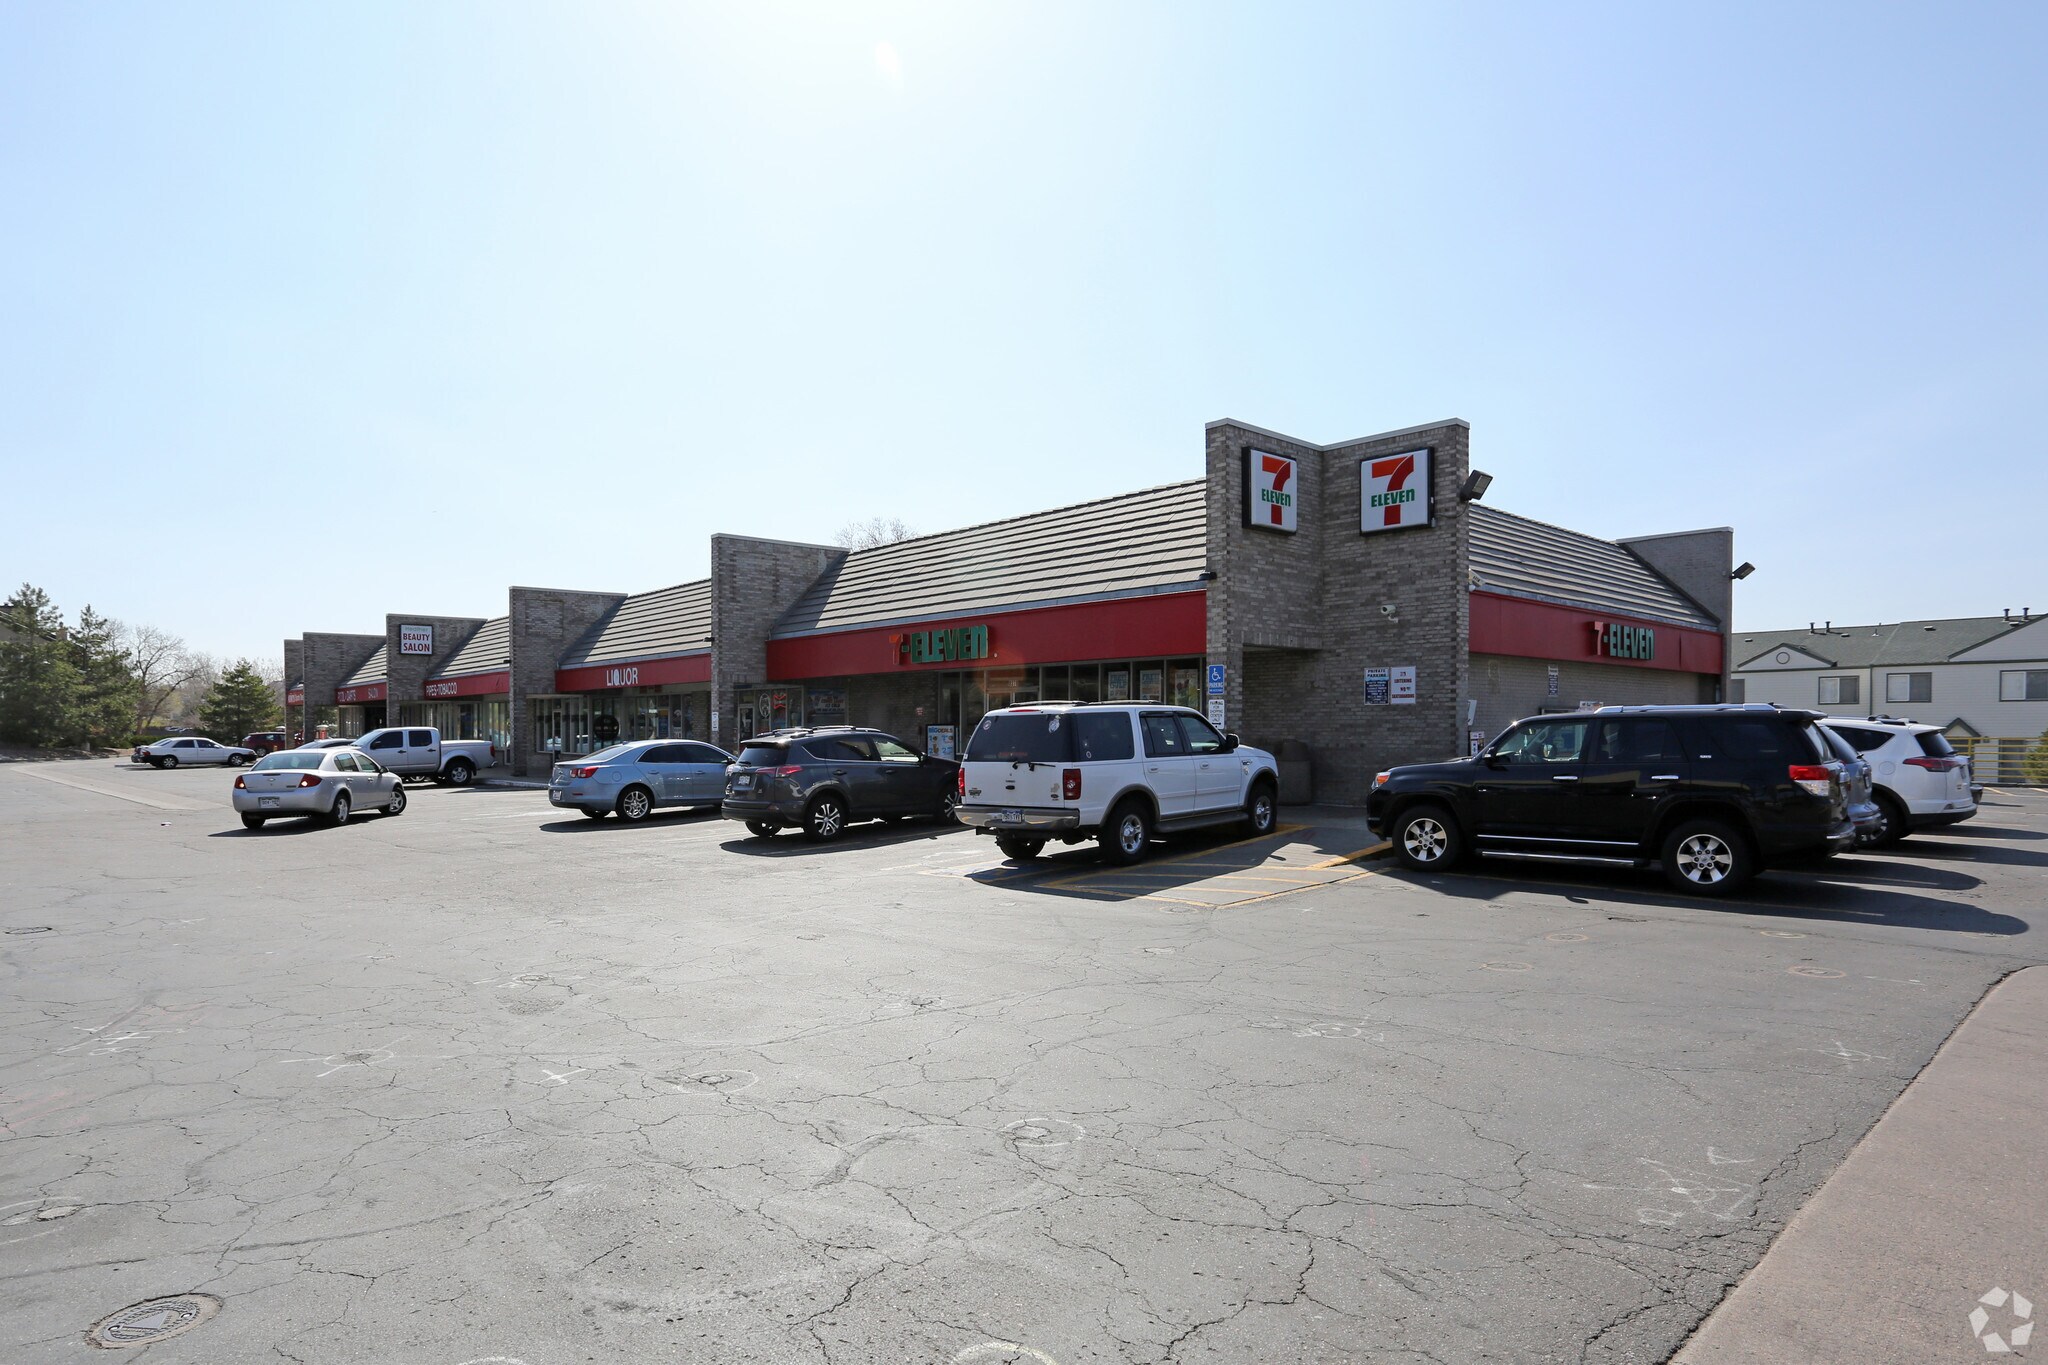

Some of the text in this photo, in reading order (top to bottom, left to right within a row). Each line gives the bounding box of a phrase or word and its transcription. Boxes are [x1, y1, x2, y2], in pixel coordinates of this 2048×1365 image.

[403, 633, 430, 641] BEAUTY
[403, 643, 430, 652] SALON
[606, 667, 639, 687] LIQUOR
